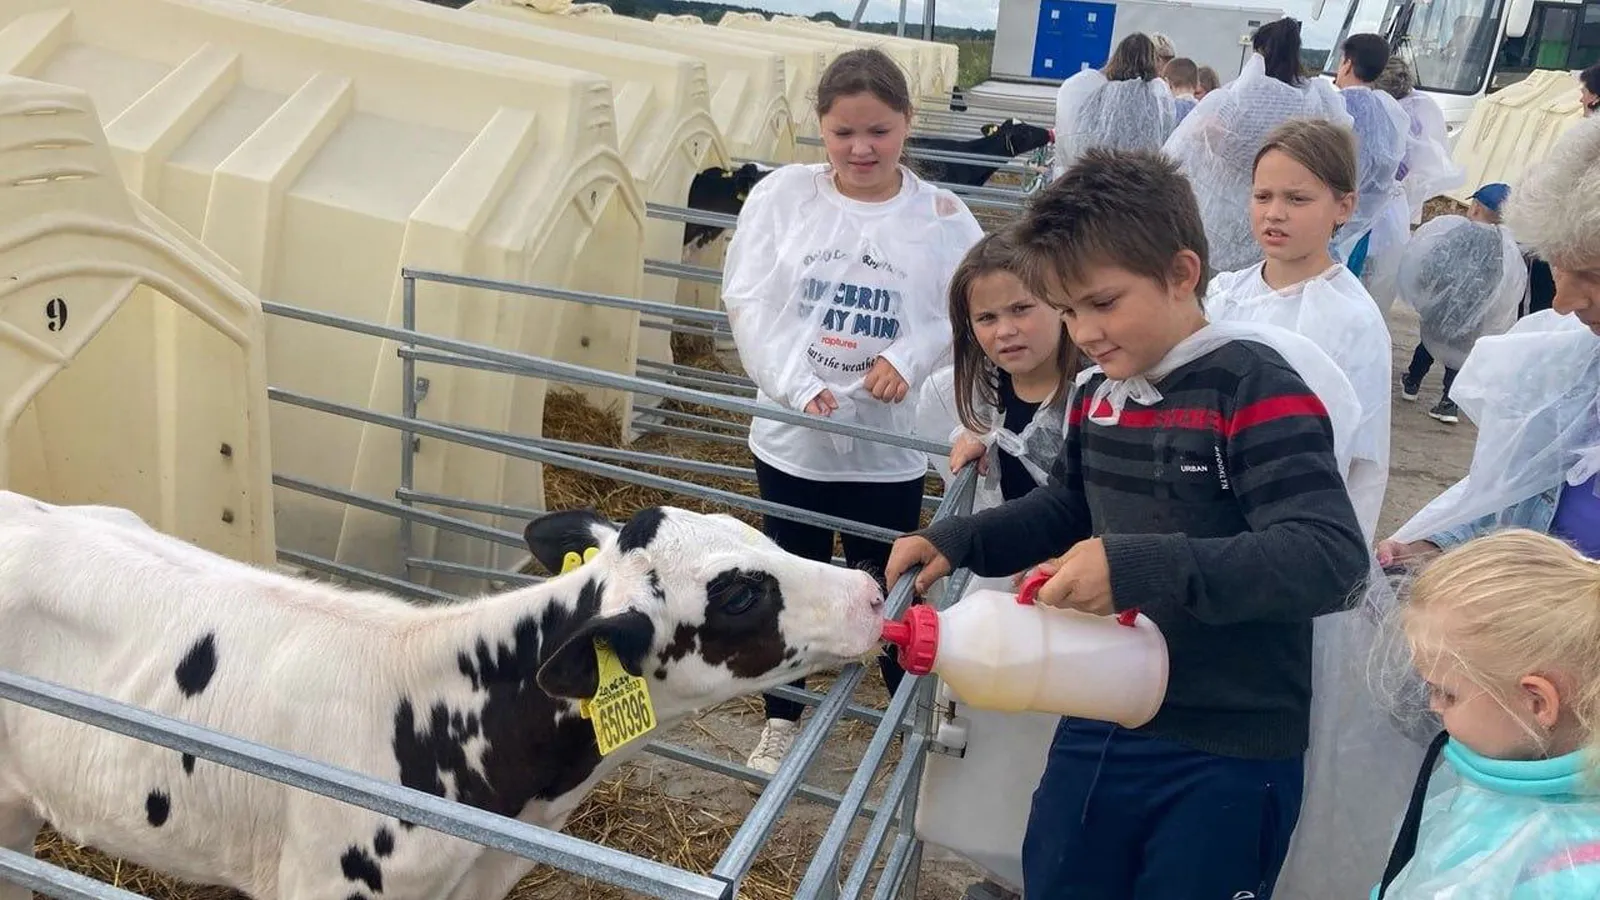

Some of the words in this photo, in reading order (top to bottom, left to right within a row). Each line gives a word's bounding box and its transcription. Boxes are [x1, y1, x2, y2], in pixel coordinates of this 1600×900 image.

[46, 298, 68, 332] 9
[821, 336, 858, 350] raptures
[824, 357, 840, 370] the
[1180, 465, 1208, 473] URBAN
[600, 690, 652, 749] 650396
